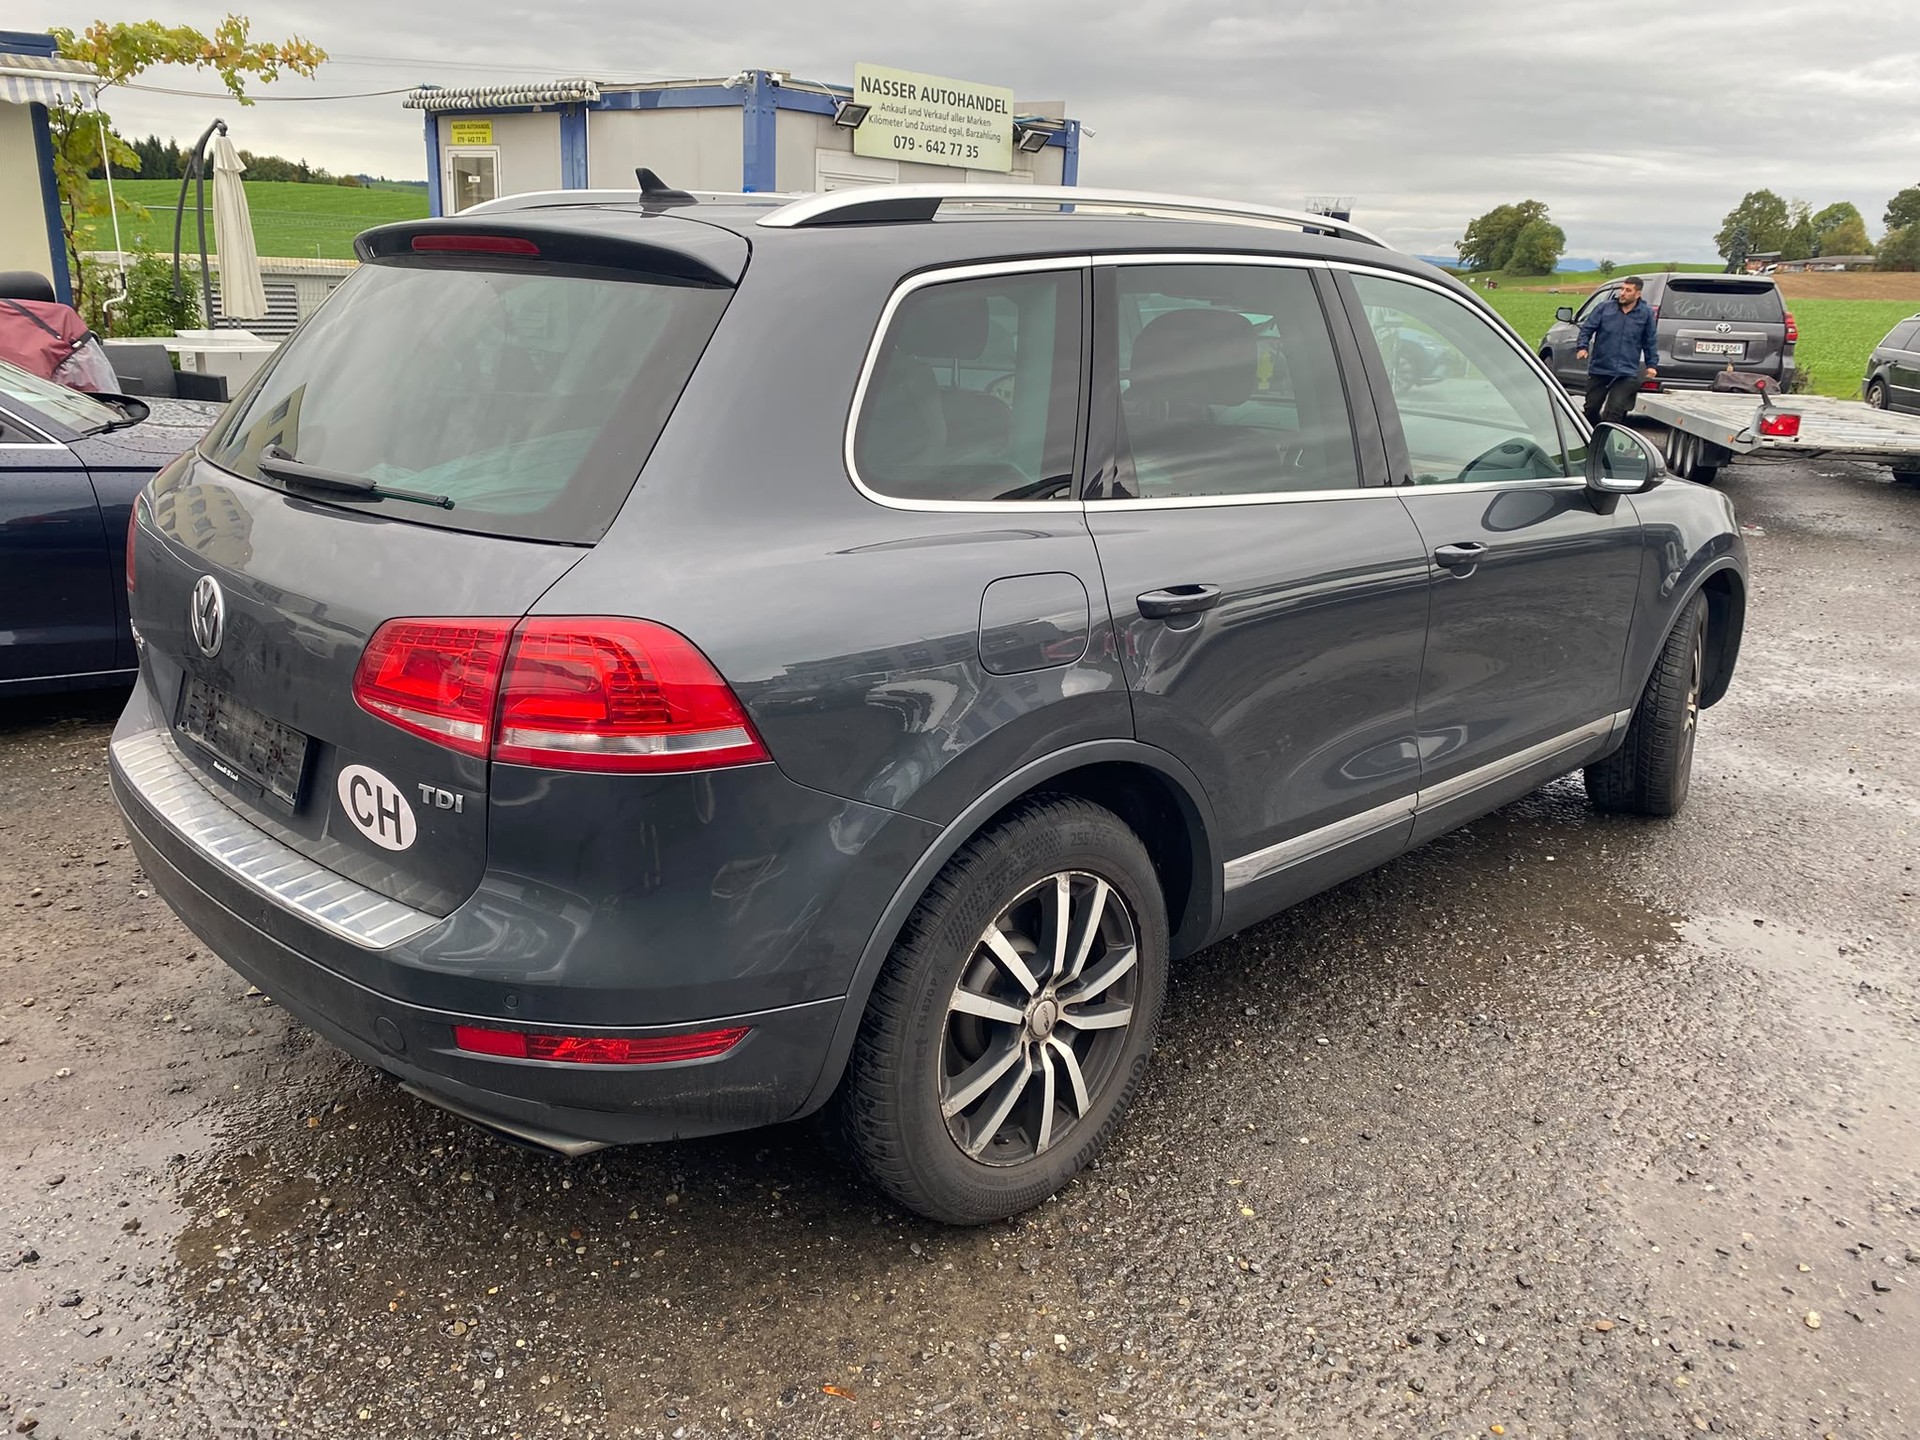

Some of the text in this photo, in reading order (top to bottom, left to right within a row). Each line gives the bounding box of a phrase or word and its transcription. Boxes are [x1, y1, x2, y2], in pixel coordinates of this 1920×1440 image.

[861, 76, 1008, 114] NASSER AUTOHANDEL
[868, 114, 1001, 143] Kilometer und Zustand egal, Barzahlung
[880, 102, 991, 127] Ankauf und Verkauf aller Marken
[893, 135, 915, 150] 079
[926, 139, 946, 155] 642
[949, 142, 963, 156] 77
[966, 145, 979, 158] 35
[350, 775, 402, 846] CH
[418, 783, 464, 813] TDI
[1073, 1053, 1147, 1171] Continental
